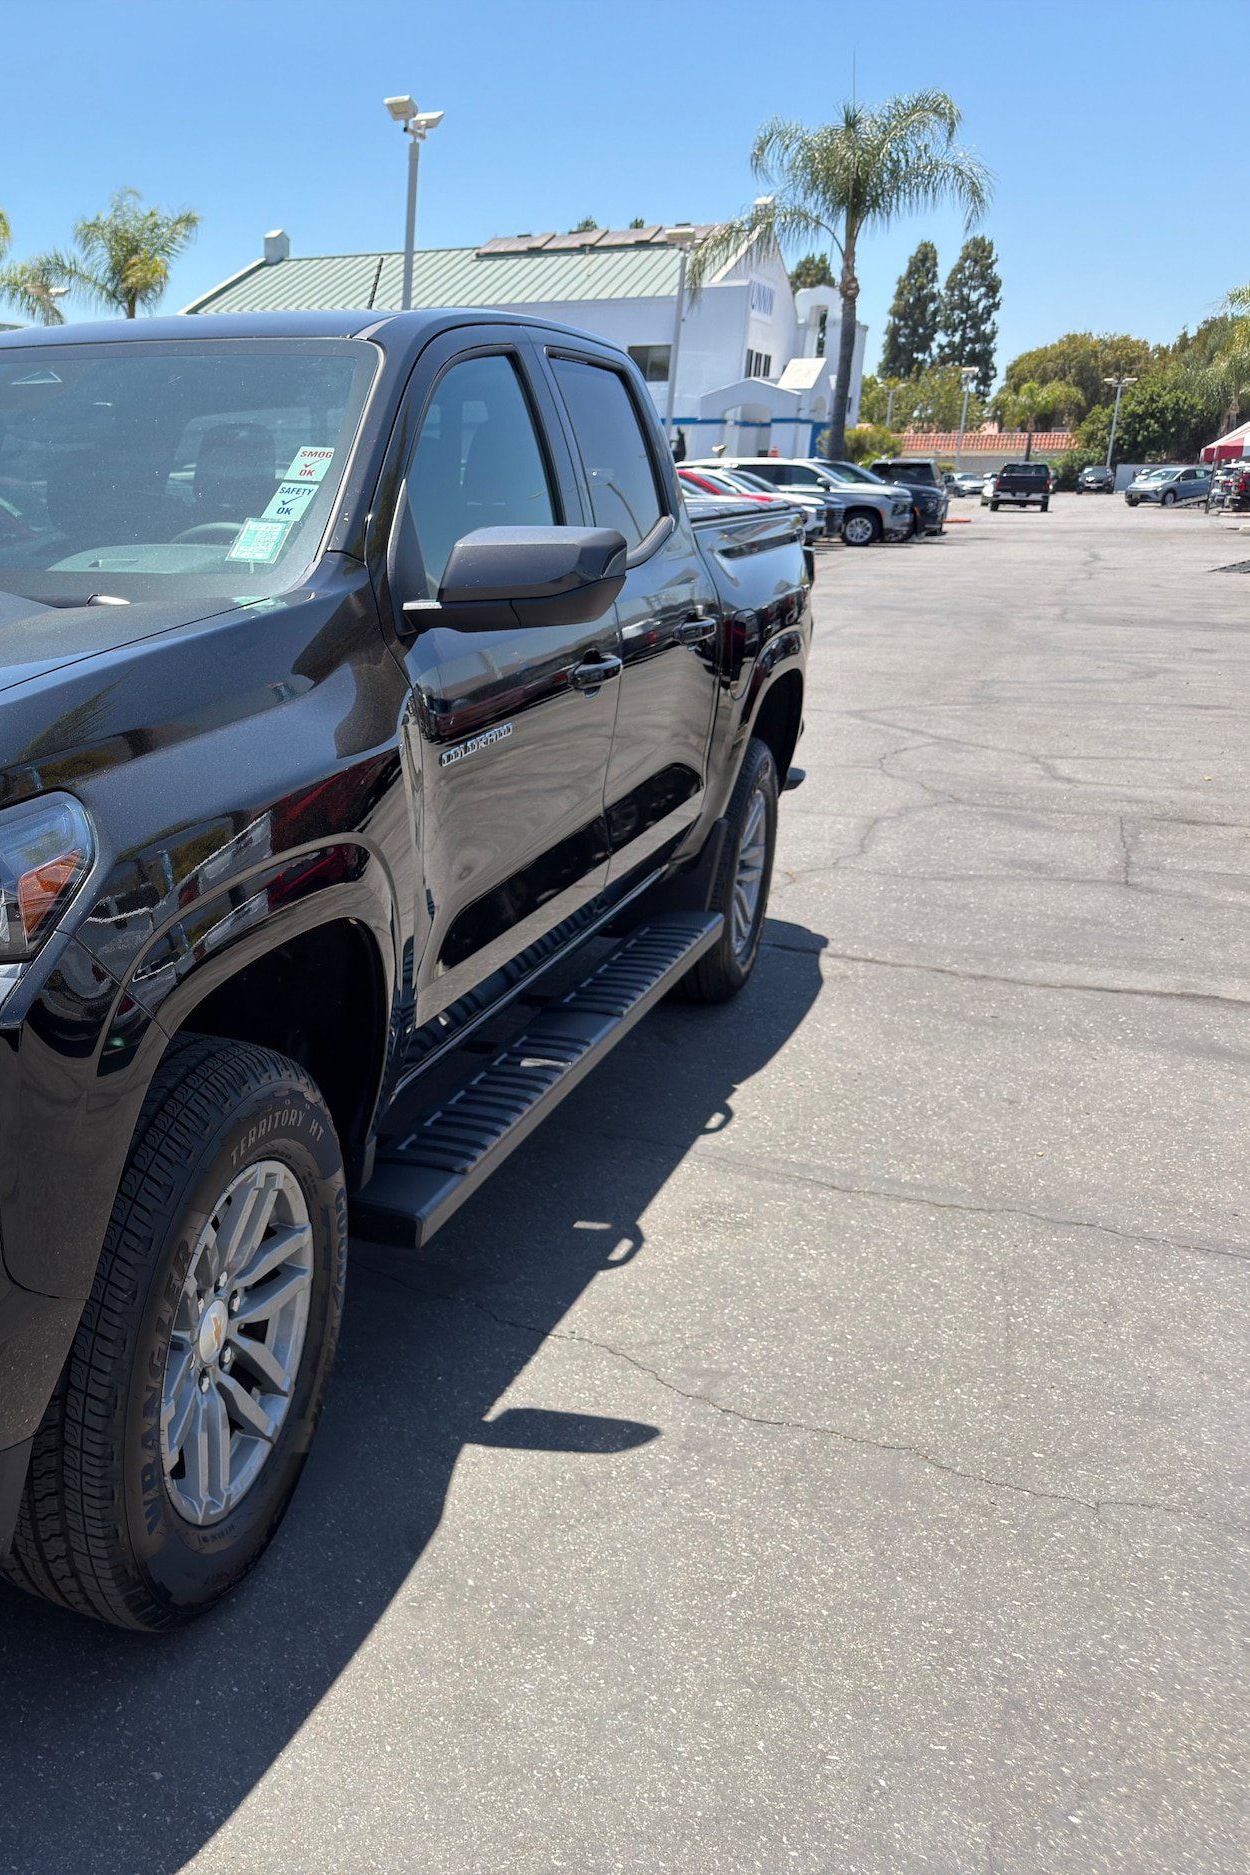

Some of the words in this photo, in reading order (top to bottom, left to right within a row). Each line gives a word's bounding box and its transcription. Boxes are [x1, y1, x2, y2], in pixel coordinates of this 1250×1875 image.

[300, 450, 333, 458] SMOG
[299, 469, 315, 477] OK
[279, 486, 315, 496] SAFETY
[276, 506, 294, 515] OK
[230, 1108, 306, 1167] TERRITORY
[308, 1118, 325, 1142] HT
